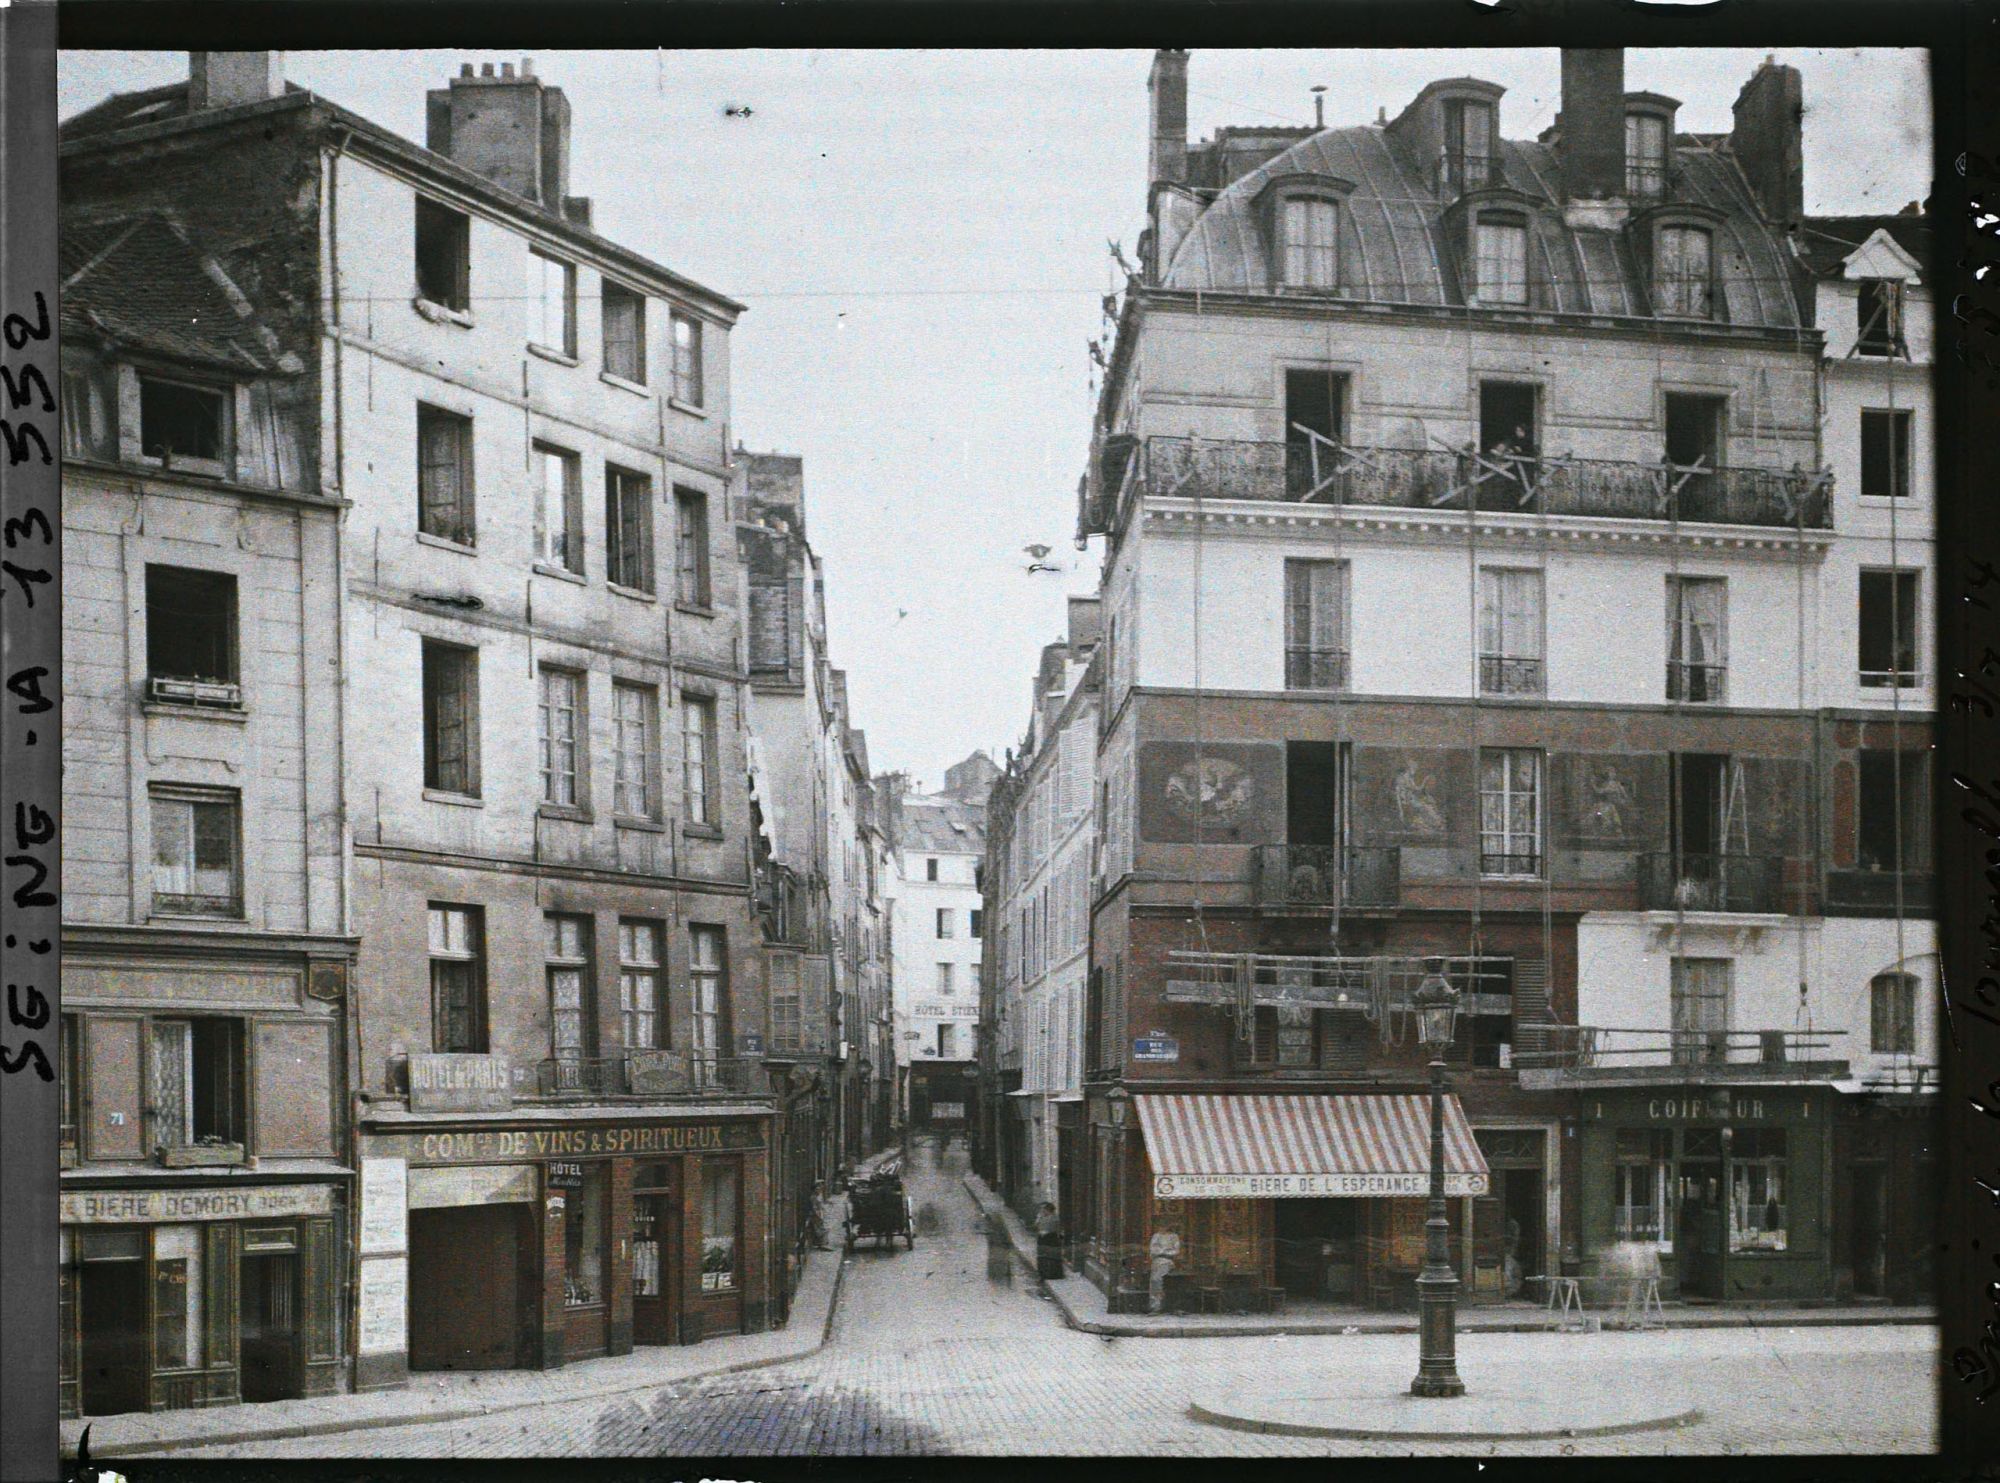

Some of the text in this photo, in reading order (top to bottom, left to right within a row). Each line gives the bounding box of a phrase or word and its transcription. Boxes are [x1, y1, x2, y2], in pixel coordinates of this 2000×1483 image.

[498, 1131, 528, 1156] DE
[534, 1129, 586, 1154] VINS
[591, 1133, 602, 1152] &
[605, 1125, 724, 1152] SPIRITUEUX
[1300, 1177, 1315, 1193] DE
[165, 1193, 251, 1216] DEMORY
